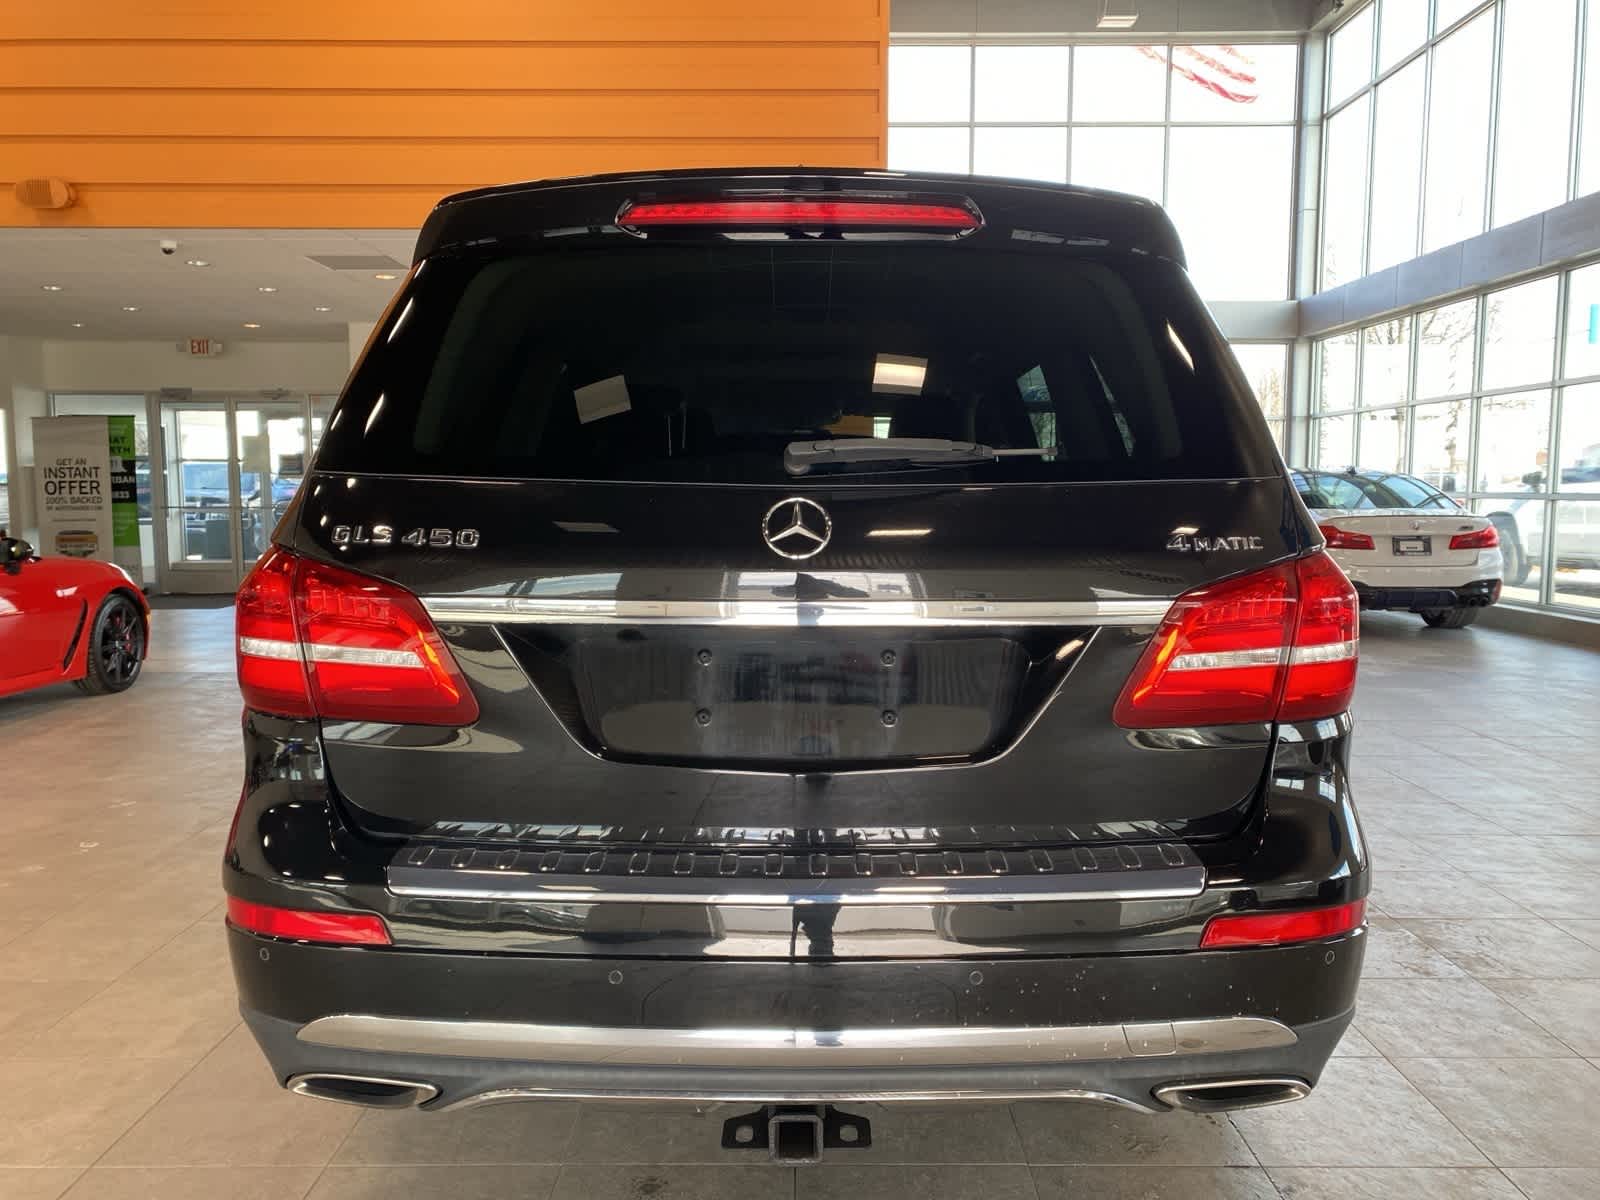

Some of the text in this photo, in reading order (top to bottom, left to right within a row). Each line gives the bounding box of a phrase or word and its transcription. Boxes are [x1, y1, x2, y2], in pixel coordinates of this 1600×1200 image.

[191, 339, 209, 355] EXIT
[56, 458, 87, 466] GET AN
[43, 466, 100, 479] INSTANT
[44, 480, 100, 495] OFFER
[45, 496, 103, 505] 100% BACKED
[331, 525, 480, 548] GLS 450
[1166, 533, 1264, 551] 4MATIC
